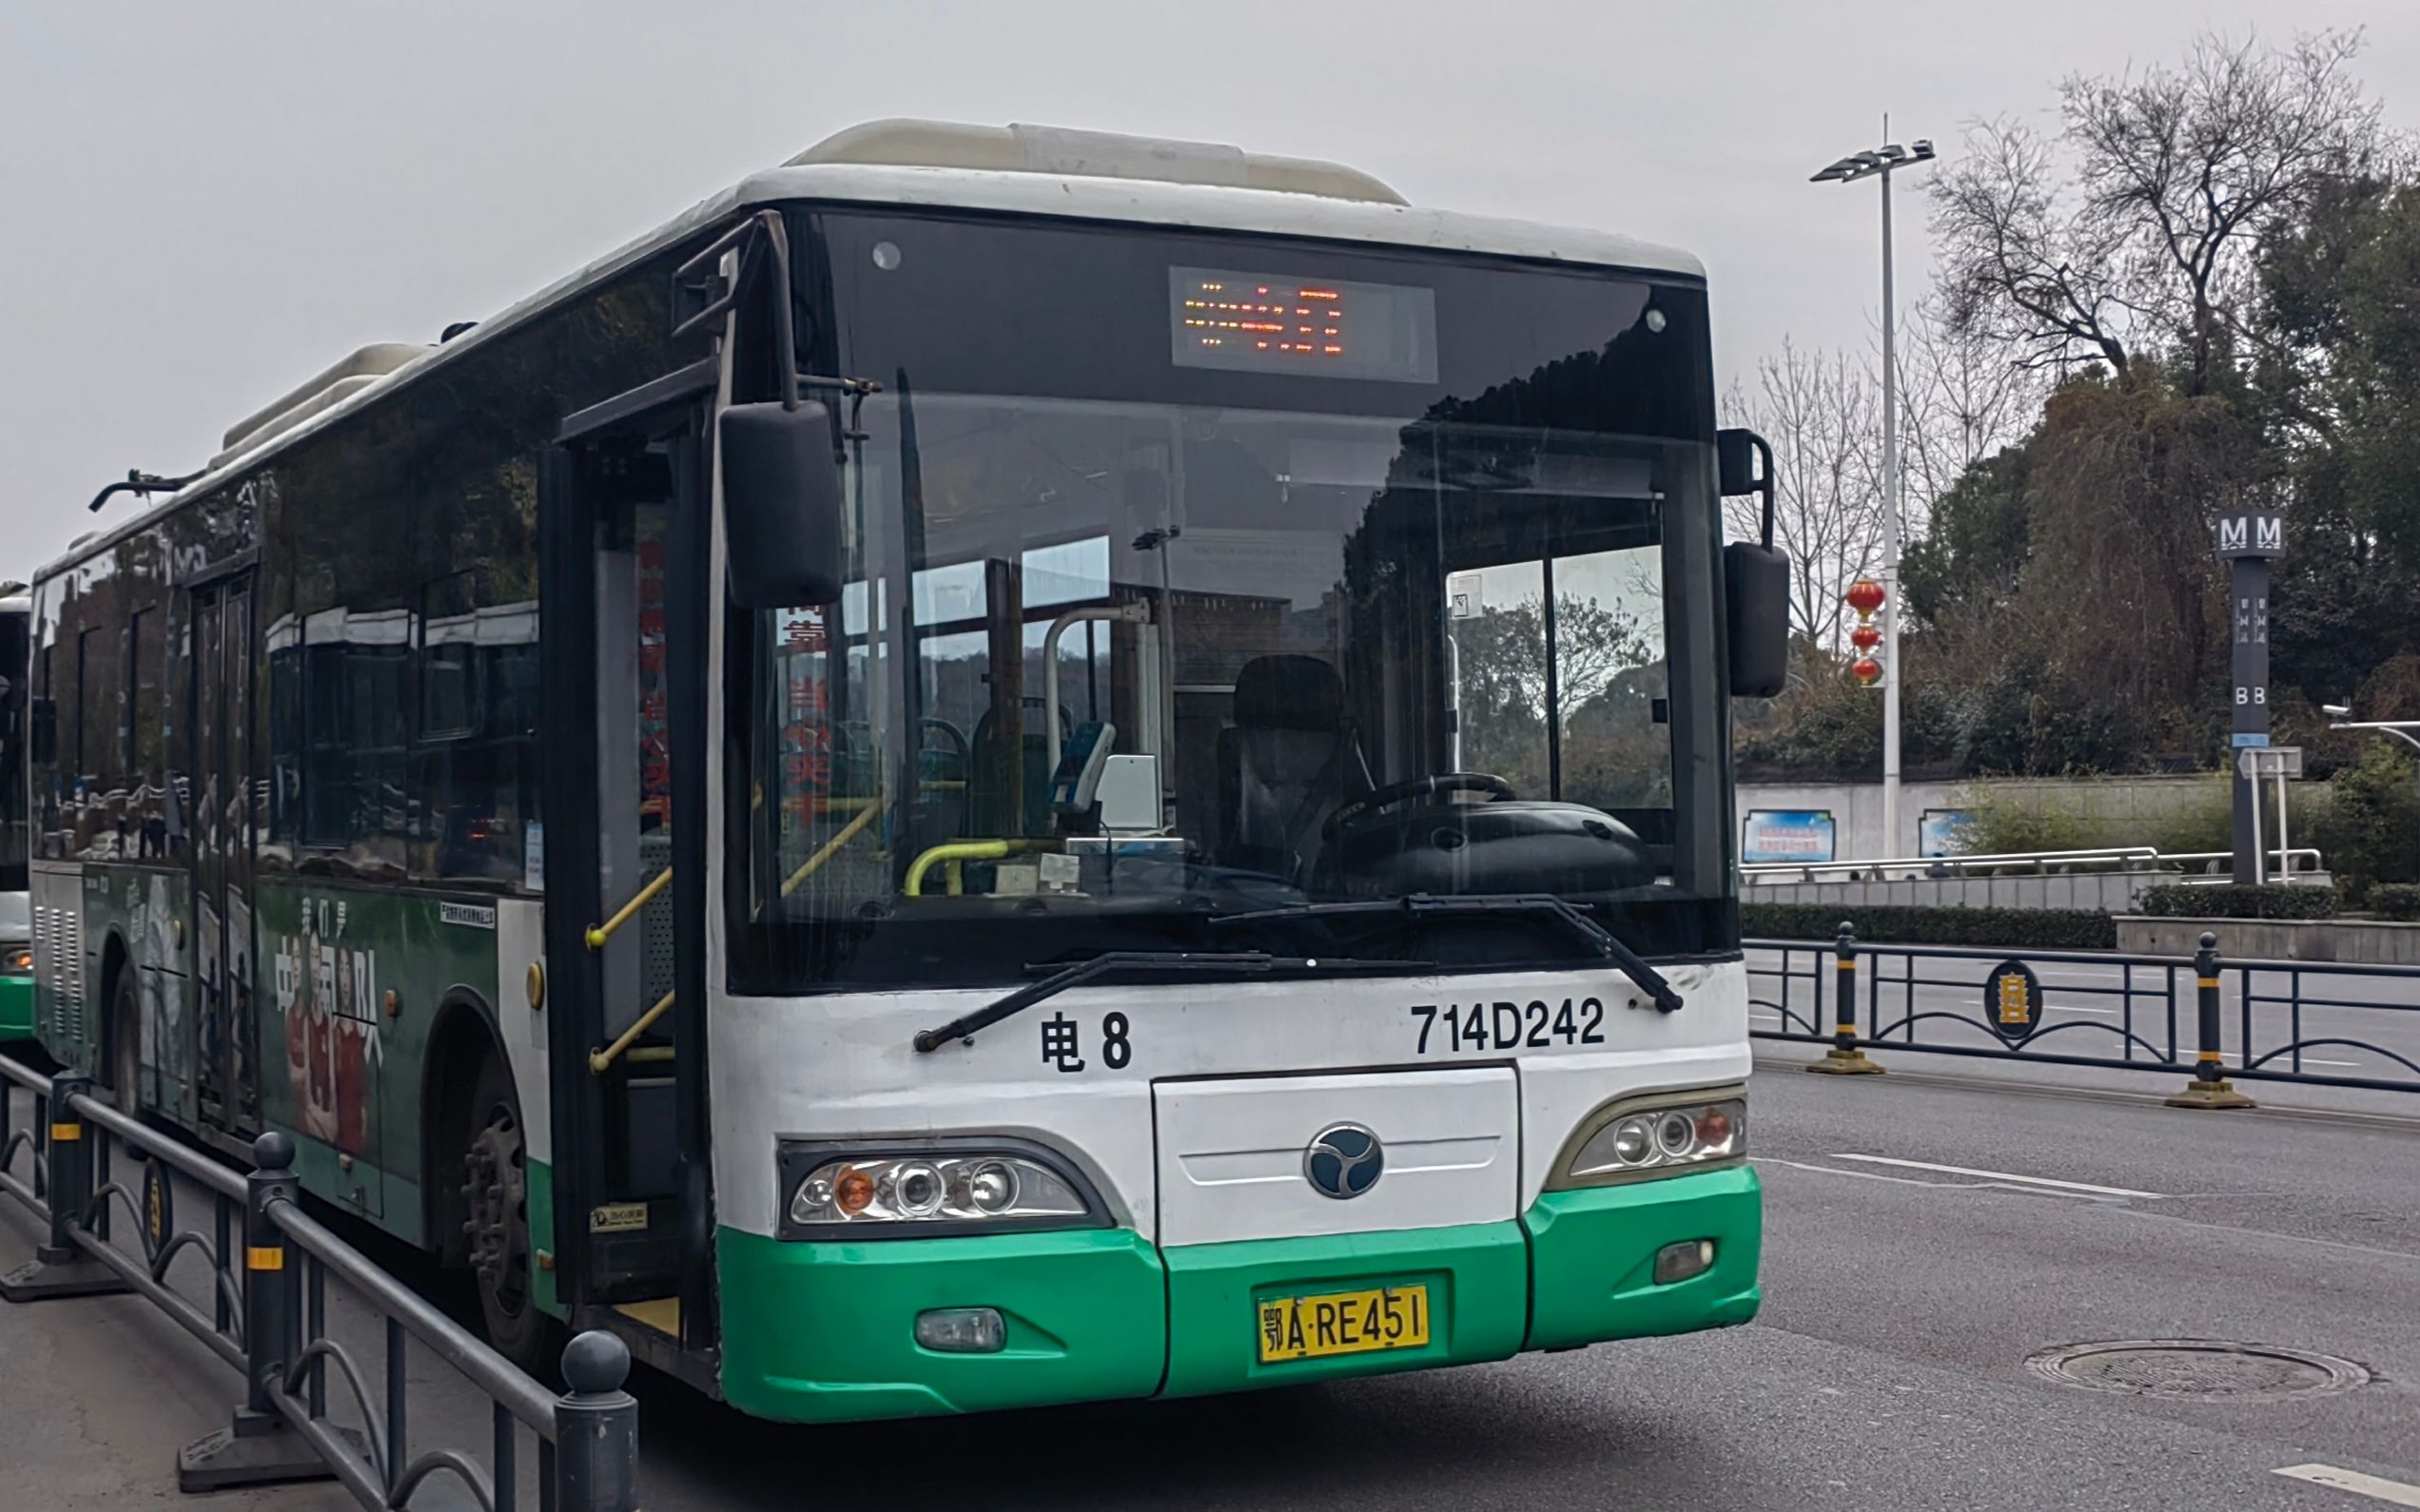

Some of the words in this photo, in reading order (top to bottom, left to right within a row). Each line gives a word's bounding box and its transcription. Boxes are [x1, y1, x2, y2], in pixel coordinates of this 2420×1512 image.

[2235, 687, 2249, 705] B
[2254, 687, 2266, 705] B
[1042, 1011, 1085, 1073] 电
[1103, 1011, 1131, 1070] 8
[1411, 997, 1605, 1054] 714D242
